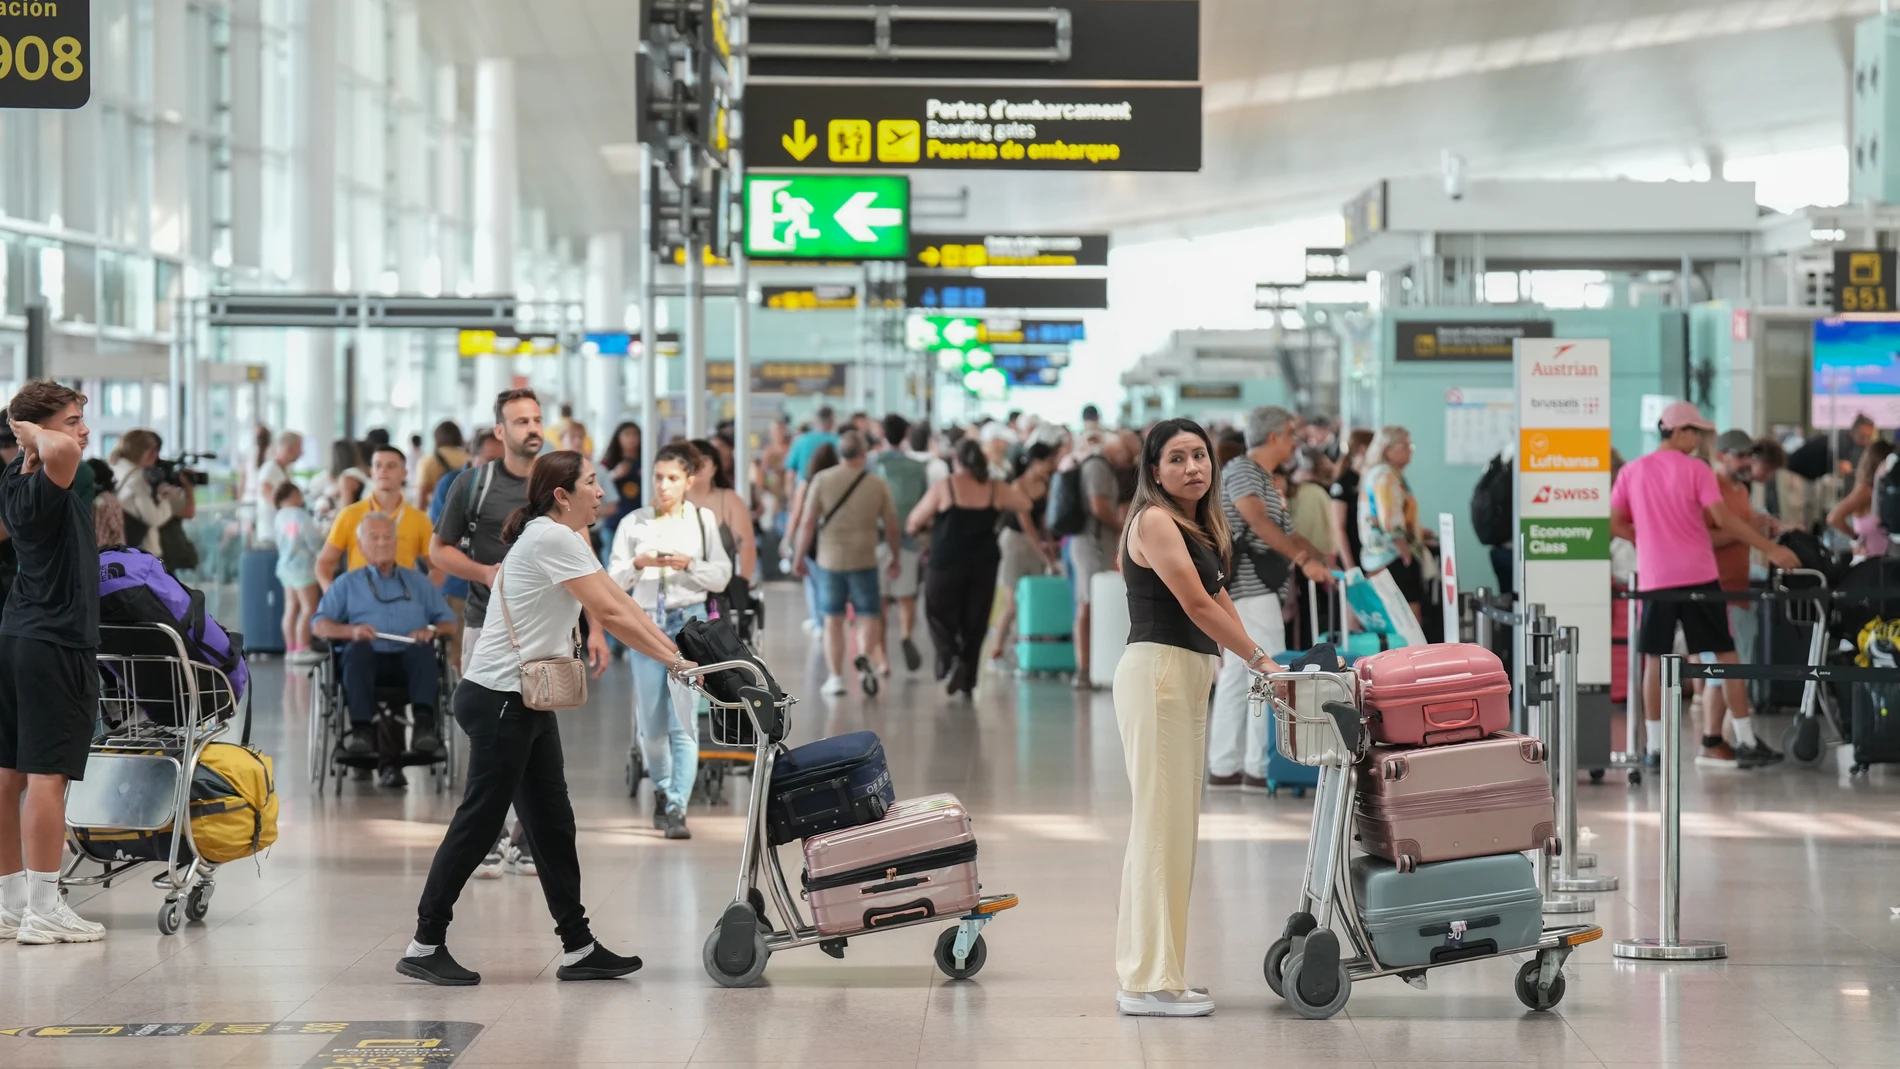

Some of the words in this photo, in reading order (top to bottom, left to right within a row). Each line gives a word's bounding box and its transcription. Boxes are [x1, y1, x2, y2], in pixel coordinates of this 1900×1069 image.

[926, 99, 987, 119] Portes
[926, 120, 992, 141] Boarding
[994, 121, 1036, 141] gates
[926, 139, 998, 159] Puertas
[1000, 140, 1025, 159] de
[1027, 140, 1120, 163] embarque
[1531, 361, 1599, 377] Austrian
[1529, 454, 1599, 468] Lufthansa
[1553, 488, 1599, 501] SWISS
[1529, 524, 1593, 541] Economy
[1529, 541, 1568, 554] Class
